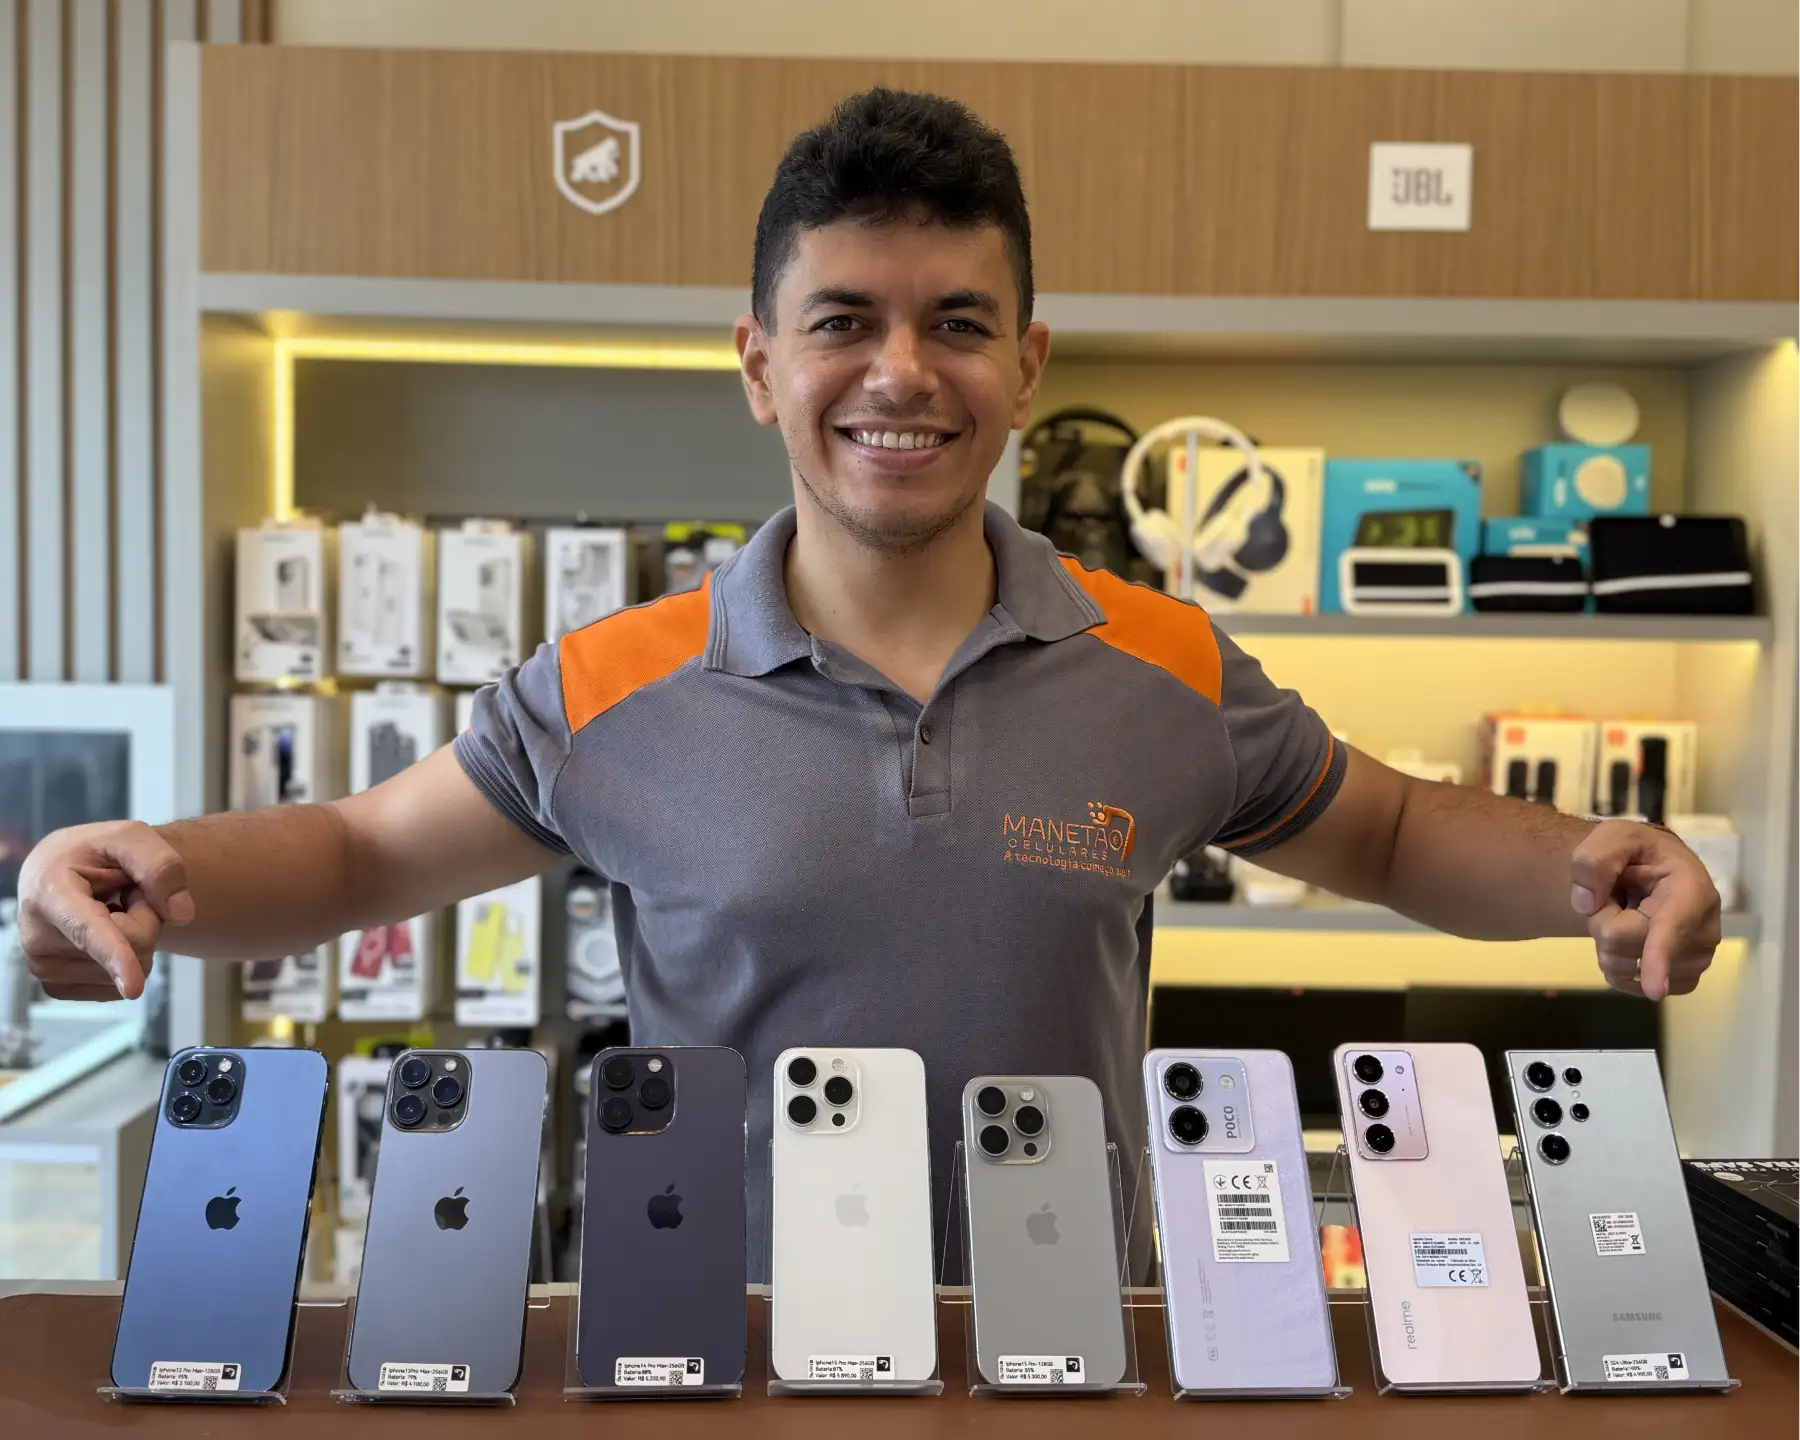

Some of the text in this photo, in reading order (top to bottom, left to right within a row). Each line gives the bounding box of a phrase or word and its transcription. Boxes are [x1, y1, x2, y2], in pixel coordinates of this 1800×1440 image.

[1391, 166, 1455, 207] JBL
[1008, 838, 1108, 860] CELULARES
[1014, 852, 1079, 870] tecnologia
[1223, 1105, 1237, 1139] POCO
[1231, 1175, 1252, 1190] CE
[1448, 1269, 1467, 1282] CE
[1401, 1300, 1418, 1350] realme
[1612, 1312, 1663, 1322] SAMSUNG
